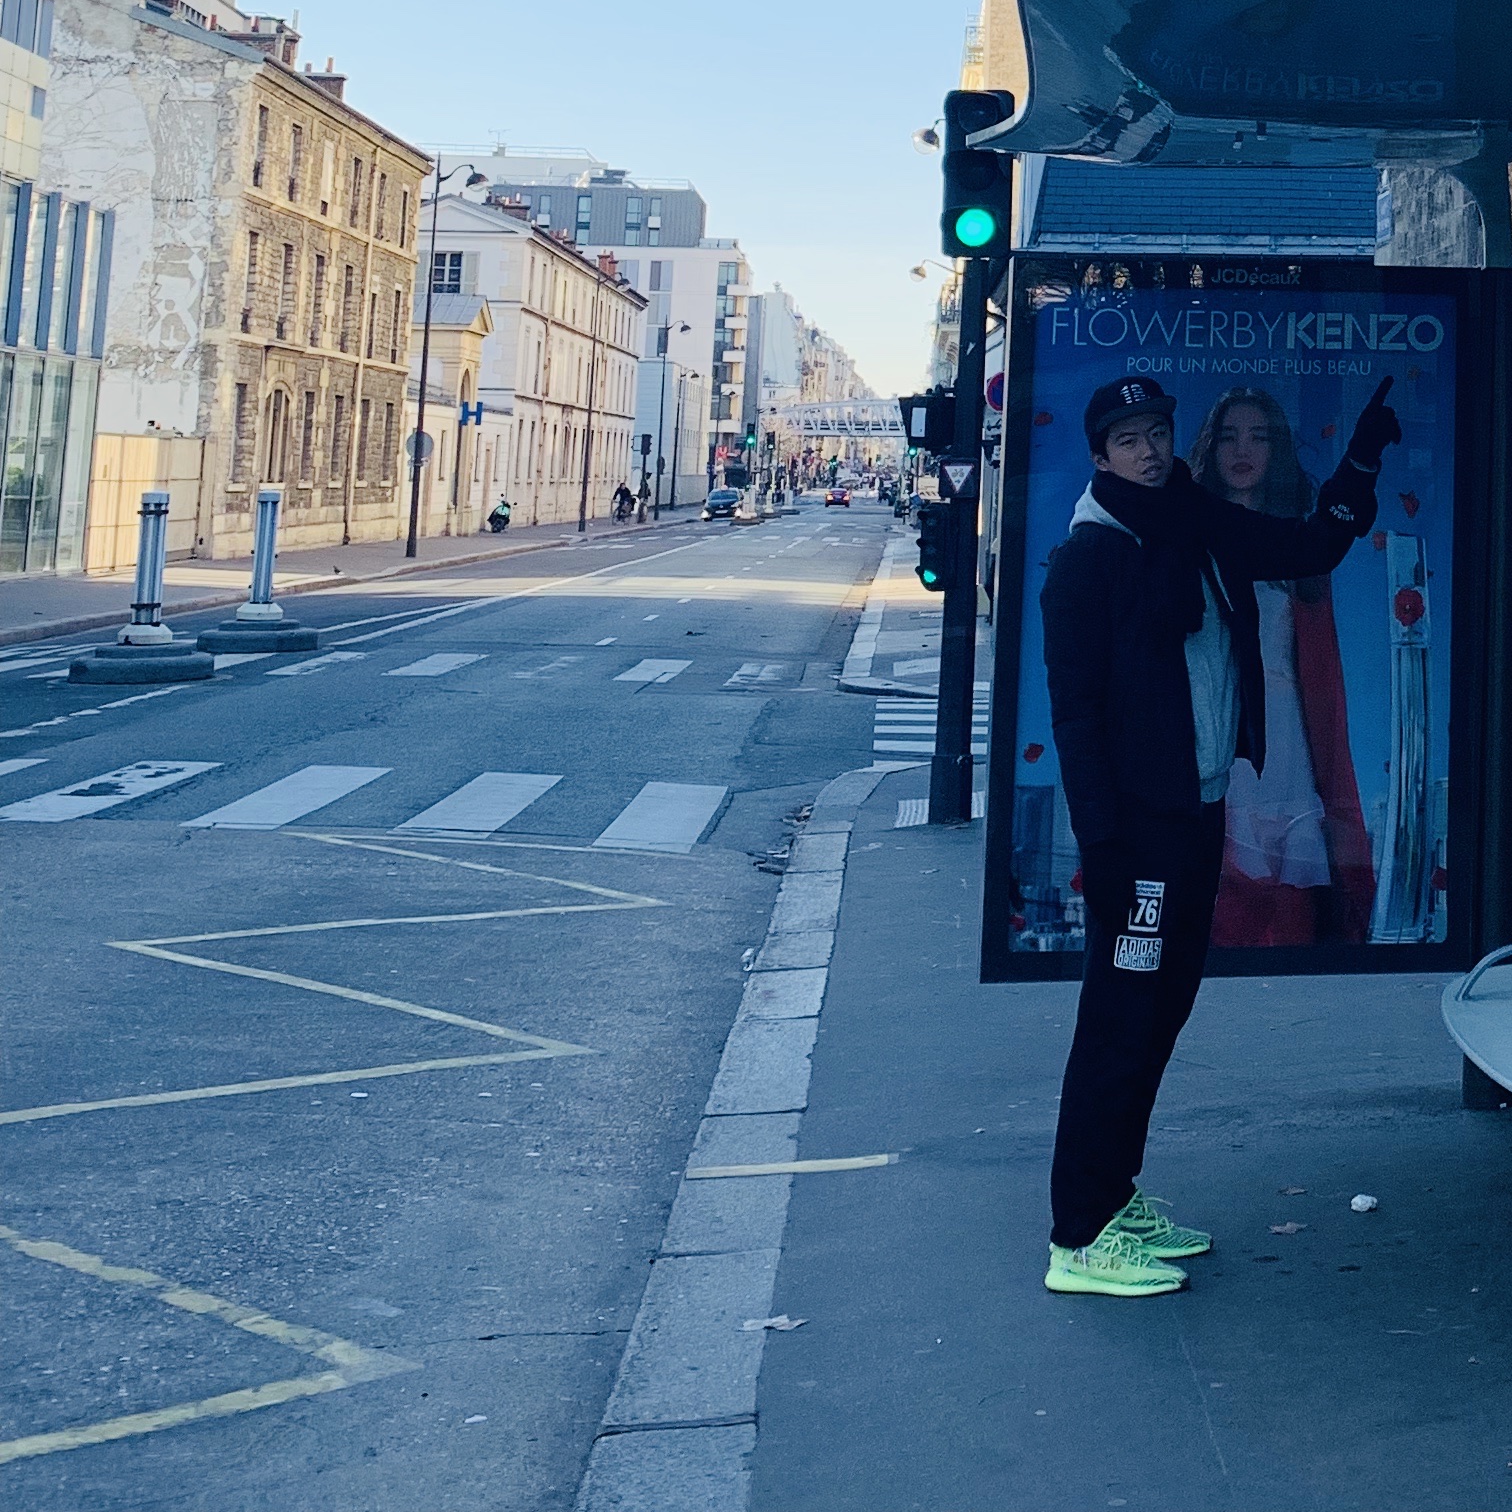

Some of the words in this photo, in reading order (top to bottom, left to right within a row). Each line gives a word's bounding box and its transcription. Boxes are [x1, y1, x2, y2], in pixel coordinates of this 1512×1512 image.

[1211, 268, 1301, 286] JCDecaux
[1126, 356, 1173, 374] POUR
[1179, 358, 1206, 374] UN
[1211, 358, 1279, 375] MONDE
[1284, 359, 1322, 376] PLUS
[1327, 360, 1372, 376] BEAU
[461, 401, 483, 426] H
[1134, 898, 1159, 925] 76
[1120, 938, 1160, 957] ADIDAS
